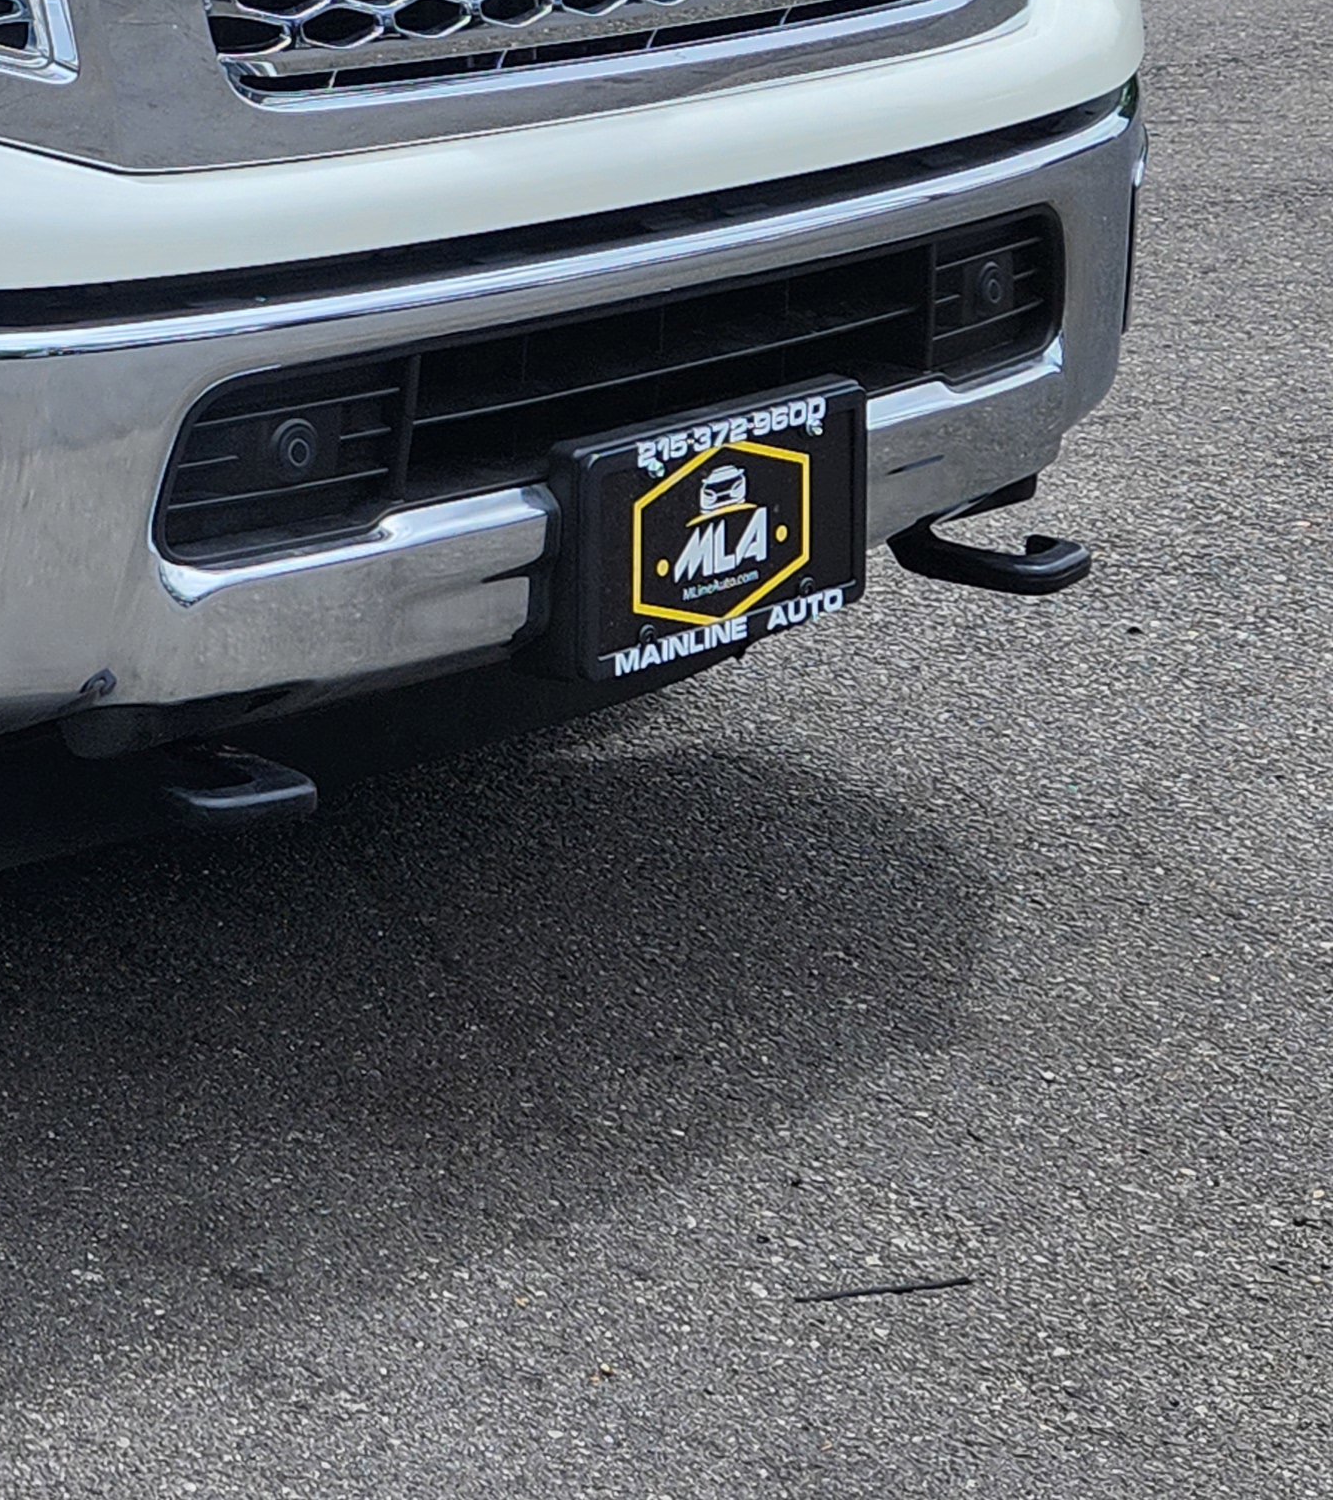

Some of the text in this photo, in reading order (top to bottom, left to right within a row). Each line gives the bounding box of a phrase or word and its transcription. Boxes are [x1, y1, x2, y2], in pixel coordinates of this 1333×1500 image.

[674, 507, 767, 583] MLA
[614, 587, 845, 677] MAINLINE AUTO
